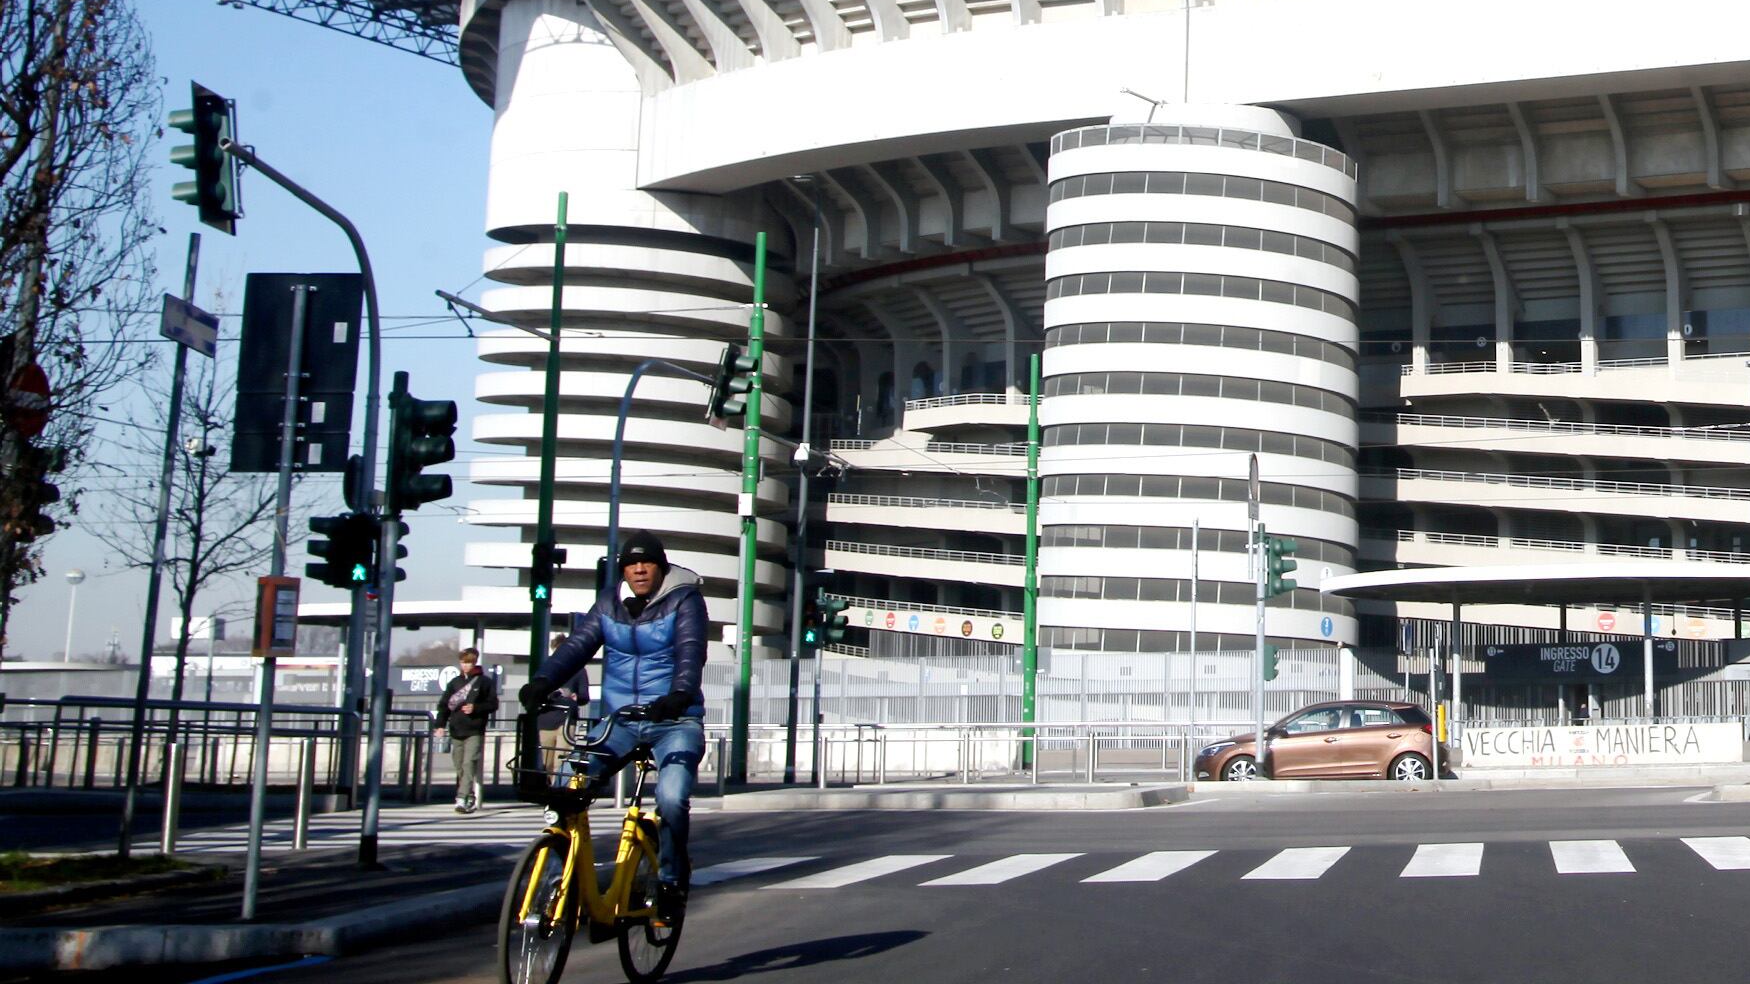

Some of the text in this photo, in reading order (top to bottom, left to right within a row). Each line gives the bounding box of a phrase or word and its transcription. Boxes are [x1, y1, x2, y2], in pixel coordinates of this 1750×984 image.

[1541, 647, 1589, 660] INGRESSO
[1595, 648, 1615, 669] 14
[1553, 660, 1576, 672] GATE
[402, 669, 439, 681] INGRESSO
[411, 680, 428, 691] GATE
[1467, 725, 1701, 756] VECCHIA MANIERA
